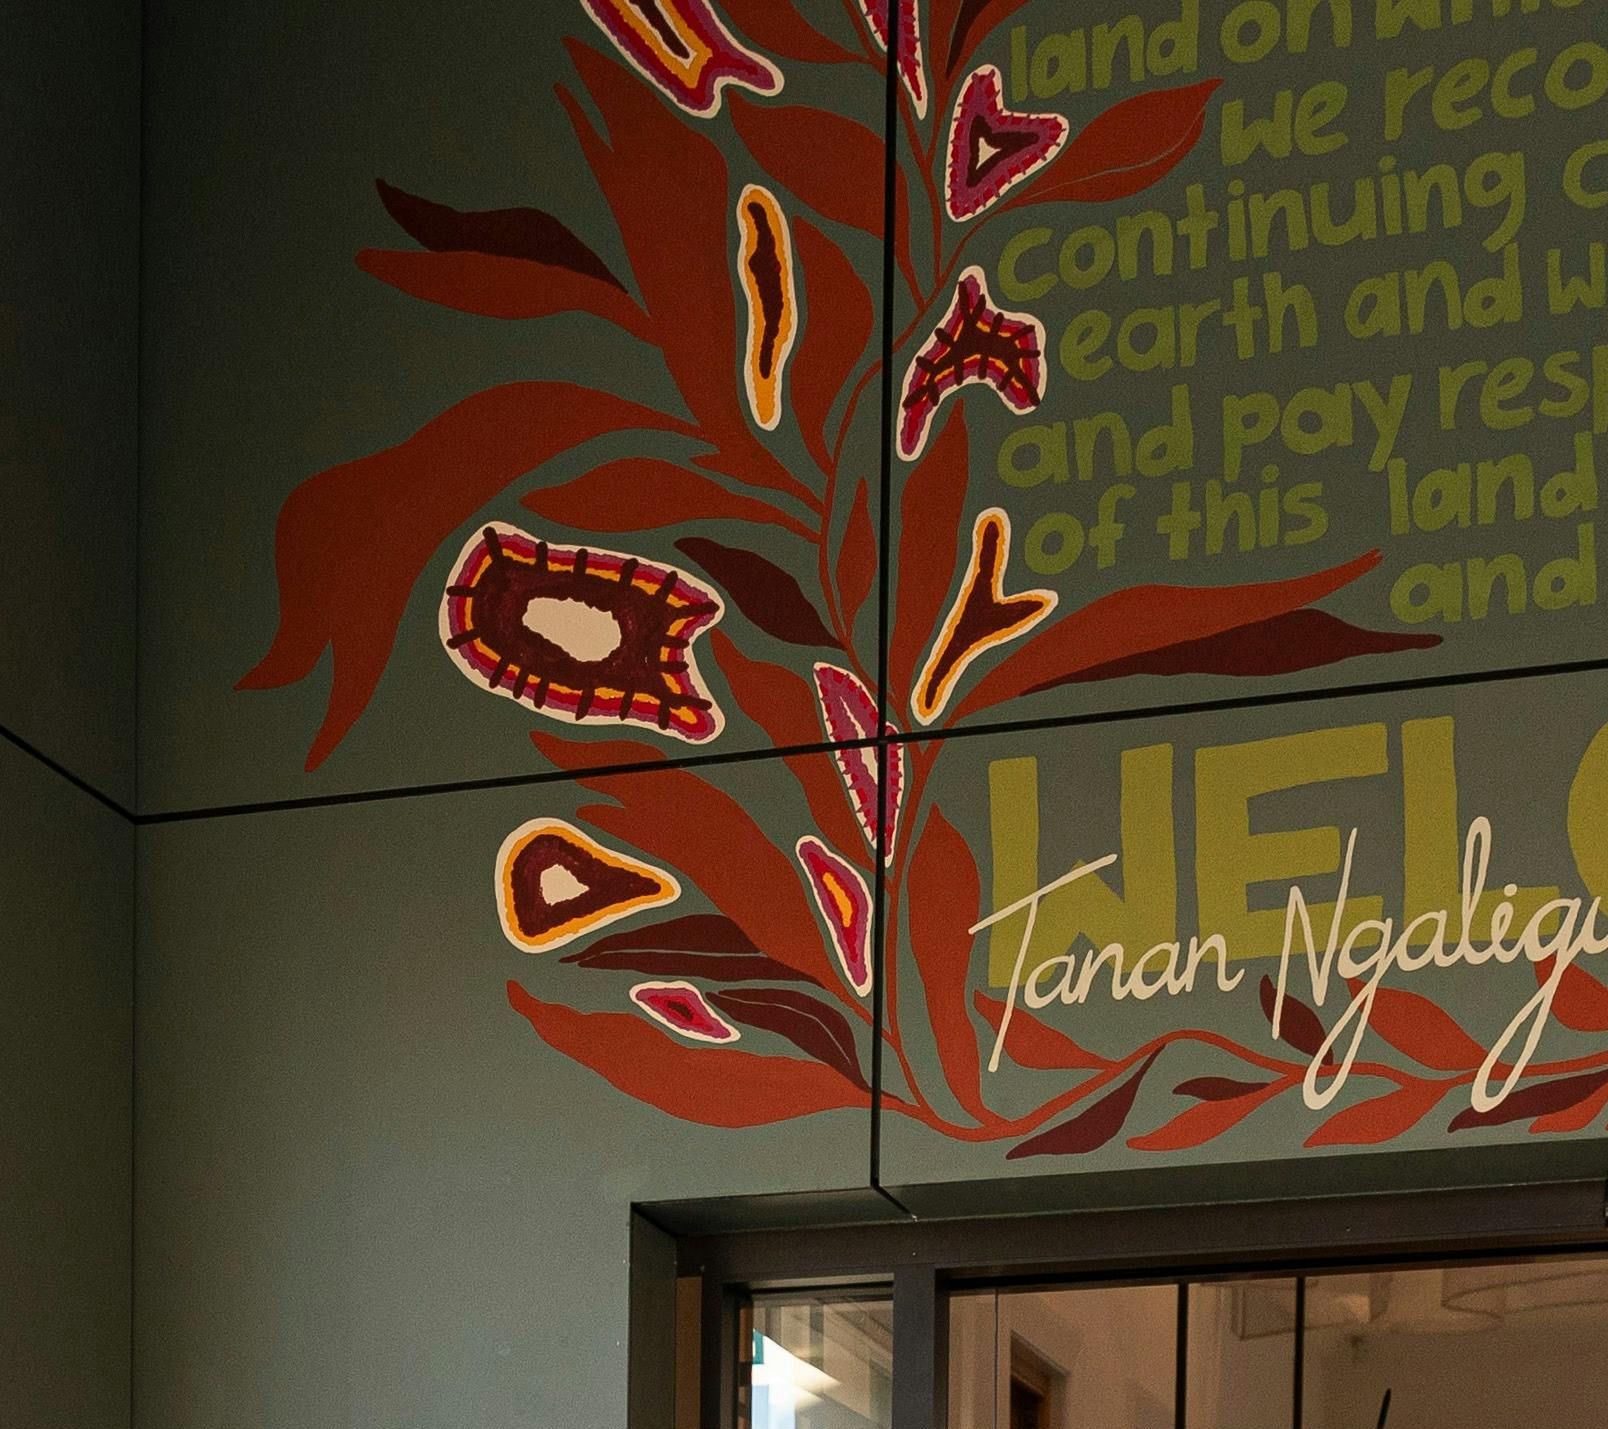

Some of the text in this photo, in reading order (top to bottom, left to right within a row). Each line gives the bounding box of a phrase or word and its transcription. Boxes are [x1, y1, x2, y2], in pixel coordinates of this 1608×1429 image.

[1009, 0, 1200, 101] land
[1220, 0, 1353, 63] on
[1221, 82, 1348, 165] we
[997, 152, 1526, 301] continuing
[1059, 273, 1319, 381] earth
[1344, 243, 1524, 339] and
[997, 385, 1194, 488] and
[1223, 374, 1413, 483] pay
[1024, 483, 1135, 575] of
[1157, 467, 1329, 560] this
[1388, 432, 1598, 535] land
[1390, 522, 1598, 625] and
[969, 853, 1244, 1072] Tanan
